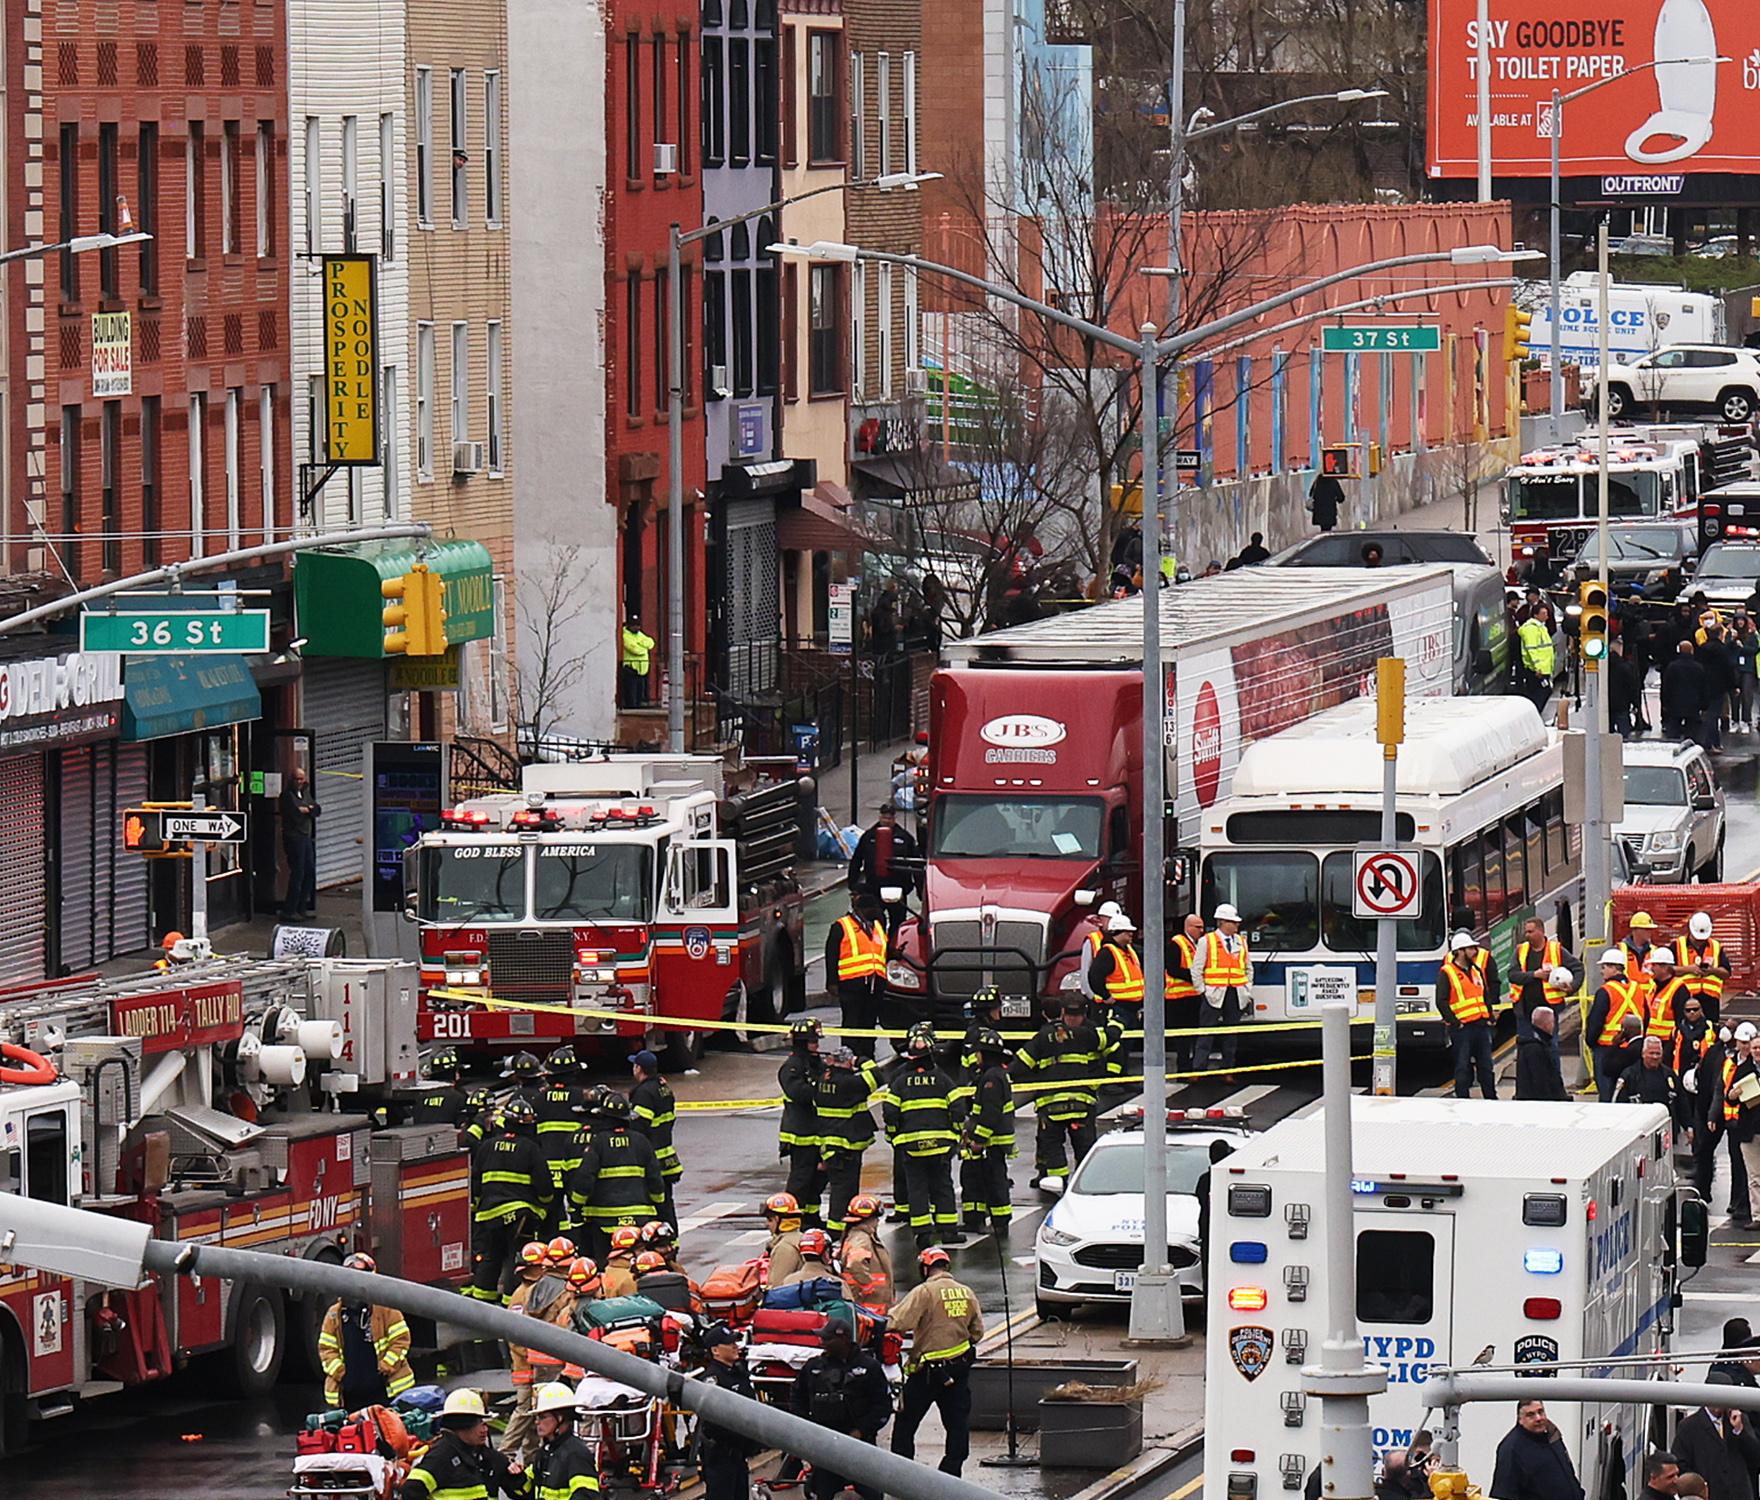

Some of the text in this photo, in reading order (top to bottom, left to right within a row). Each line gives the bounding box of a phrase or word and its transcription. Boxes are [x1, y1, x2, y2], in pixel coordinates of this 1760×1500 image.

[1516, 20, 1624, 48] GOODBYE
[1497, 57, 1560, 79] TOILET
[1466, 113, 1532, 127] AVLABLE AT
[1605, 177, 1680, 192] OUTFRONT
[93, 316, 129, 342] BUILDING
[1353, 332, 1410, 346] 37 St
[93, 347, 129, 371] FOR SALE
[331, 262, 349, 458] PROSPERITY
[352, 299, 370, 419] NOODLE
[130, 620, 223, 646] 36 St
[986, 749, 1056, 763] CARRIERS
[172, 820, 233, 832] ONE WAY
[454, 846, 596, 859] GOD BLESS AMERICA
[469, 932, 592, 943] F.D. N.Y.
[118, 993, 240, 1037] LADDER 114 TALLY HO
[433, 1014, 472, 1038] 201
[309, 1196, 338, 1231] FDNY
[1596, 1210, 1631, 1281] POLICE
[1516, 1338, 1557, 1354] POLICE
